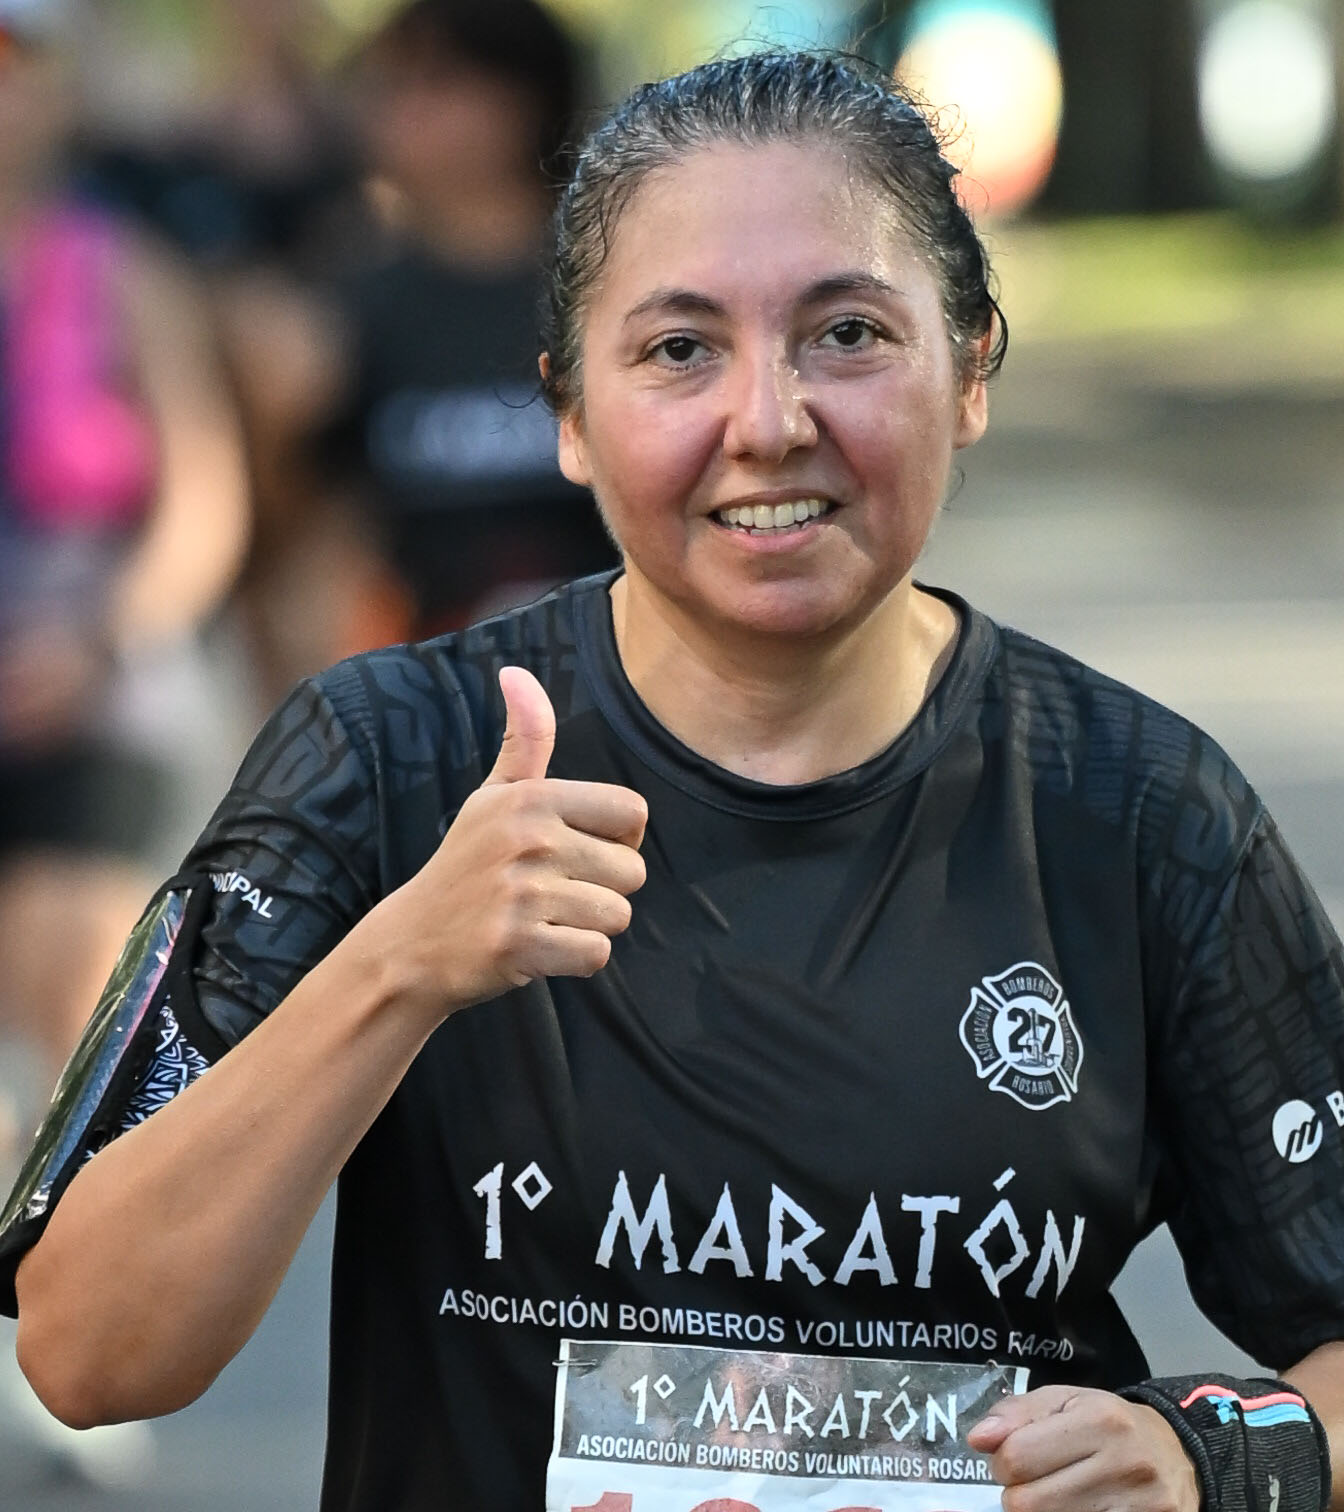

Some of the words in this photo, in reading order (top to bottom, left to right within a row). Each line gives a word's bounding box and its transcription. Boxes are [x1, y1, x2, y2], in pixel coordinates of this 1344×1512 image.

[1007, 1007, 1057, 1054] 27
[595, 1167, 1086, 1302] MARATÓN
[439, 1288, 608, 1329] ASOCIACIÓN
[619, 1304, 785, 1344] BOMBEROS
[796, 1319, 998, 1351] VOLUNTARIOS
[692, 1375, 957, 1443] MARATÓN
[577, 1434, 690, 1464] ASOCIACIÓN
[696, 1445, 799, 1472] BOMBEROS
[805, 1452, 923, 1478] VOLUNTARIOS
[928, 1457, 992, 1481] ROSAR
